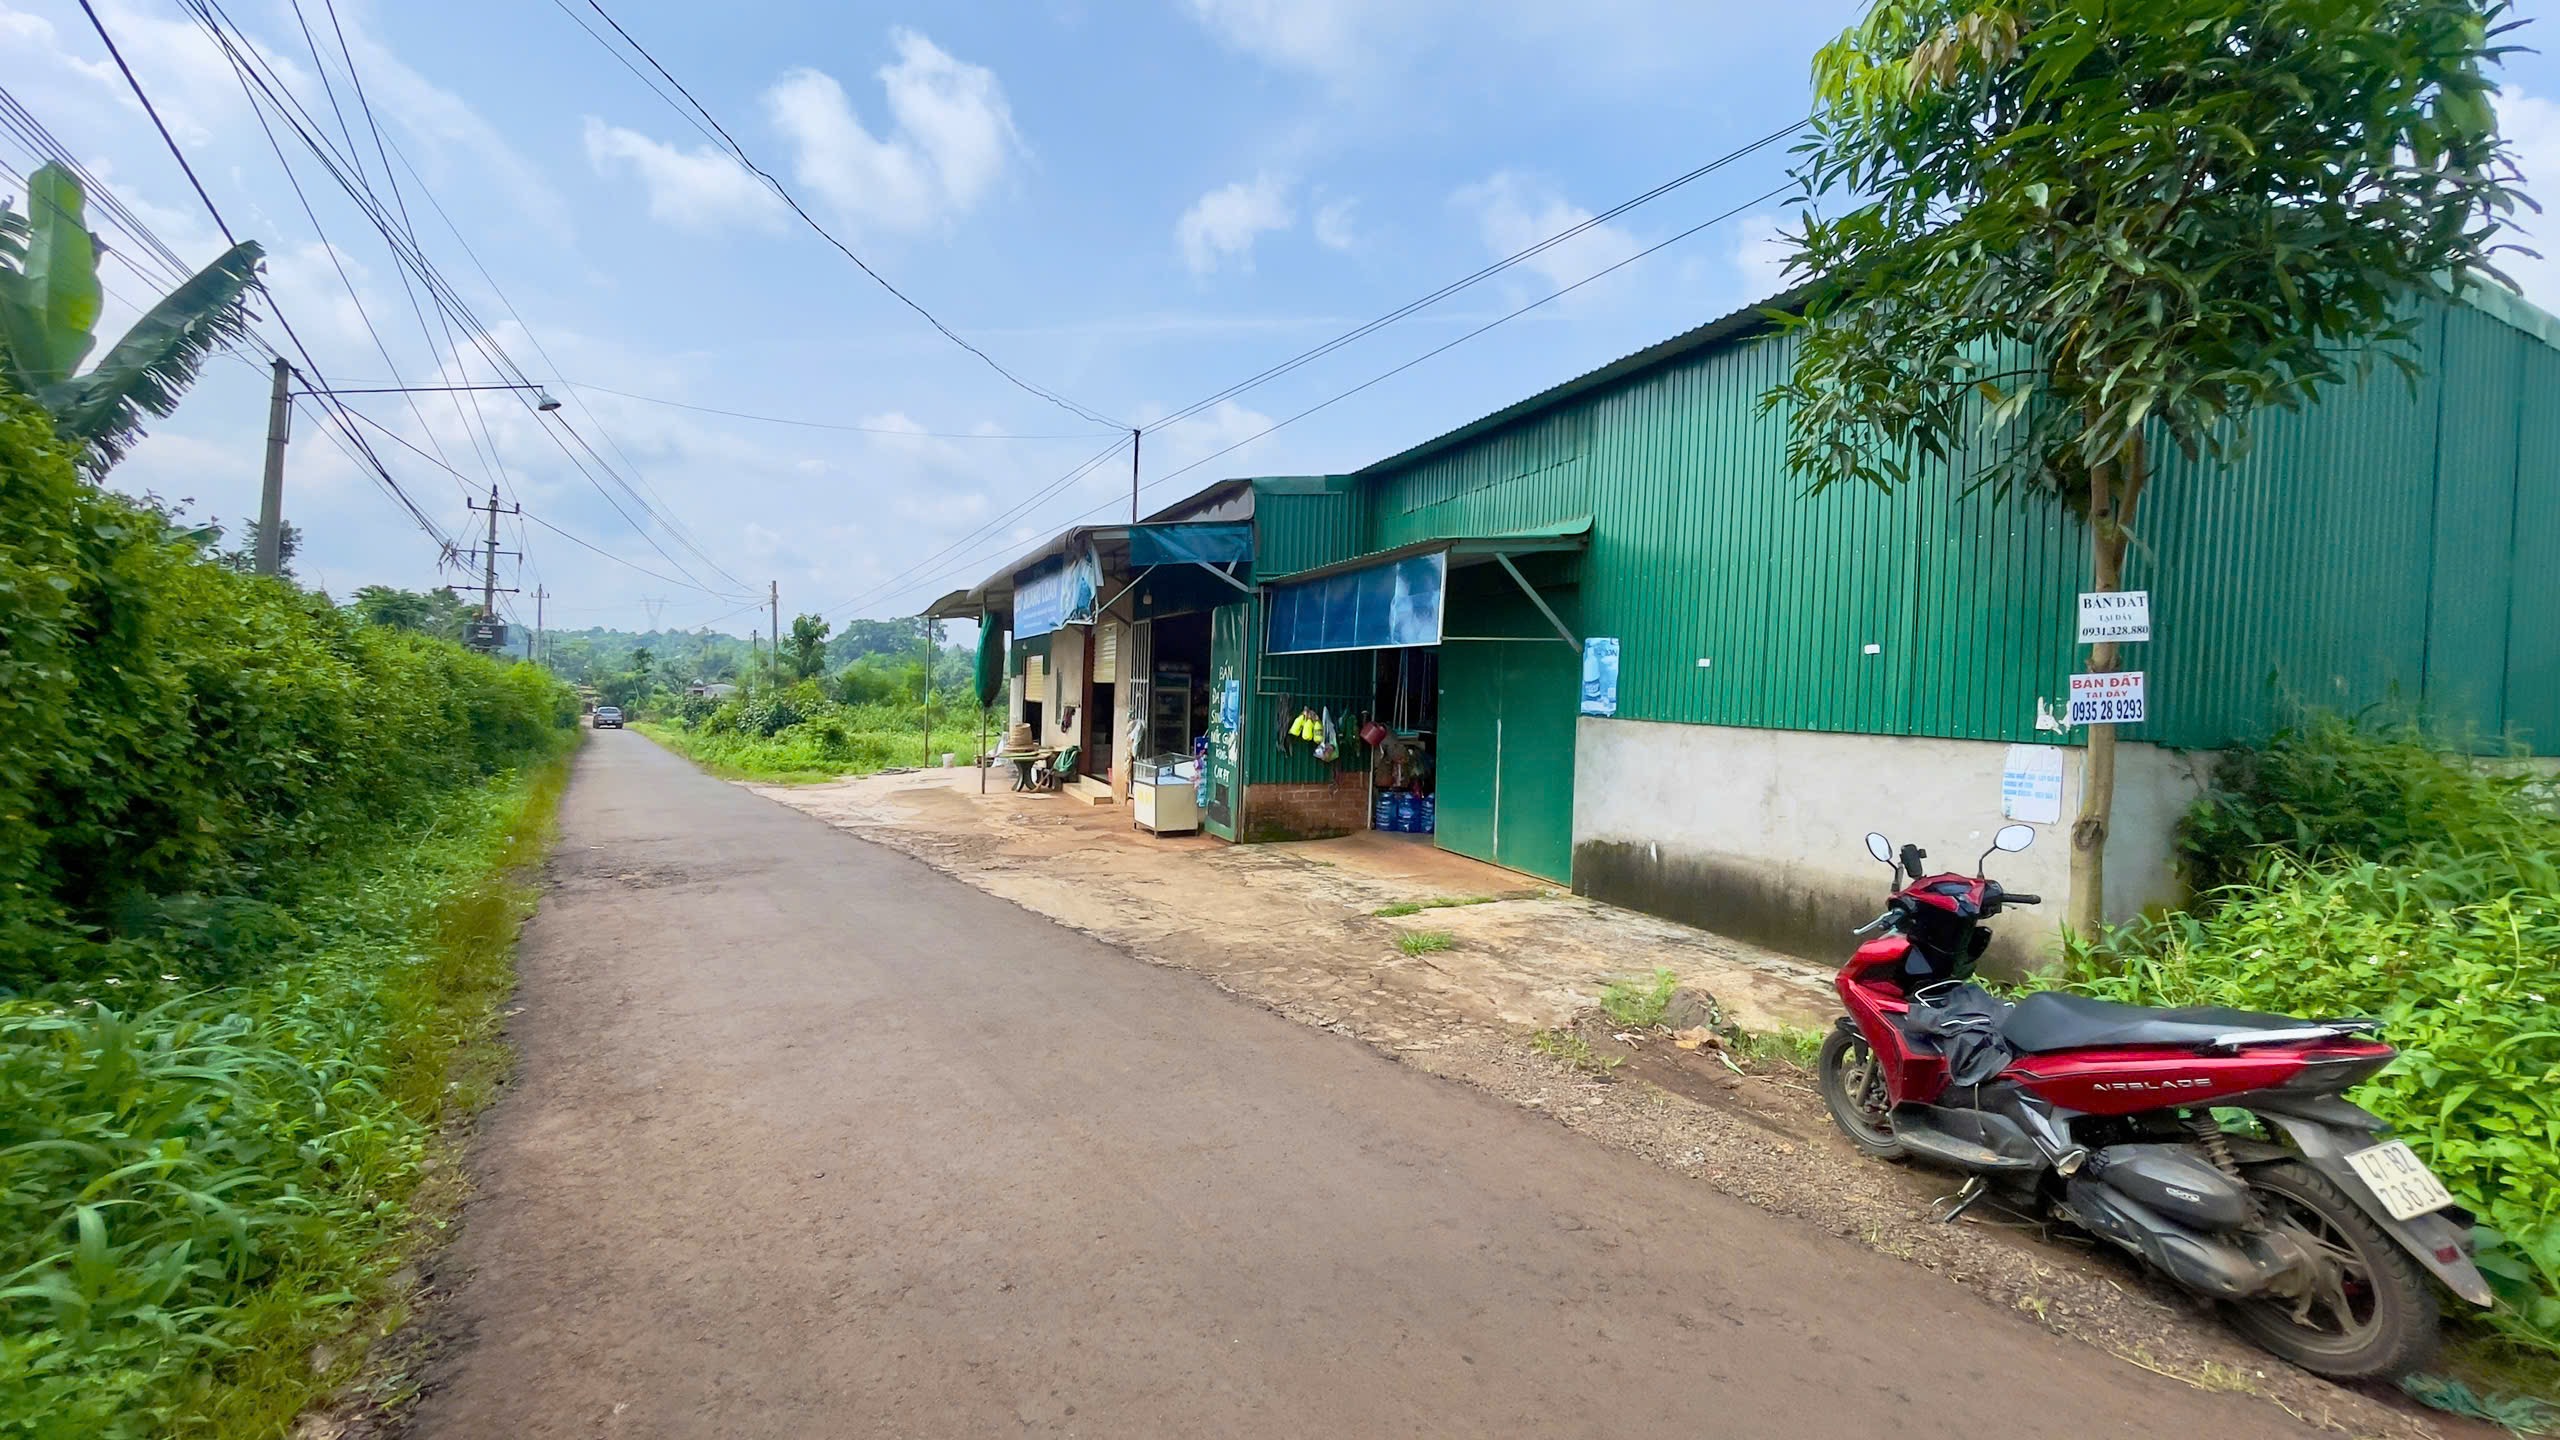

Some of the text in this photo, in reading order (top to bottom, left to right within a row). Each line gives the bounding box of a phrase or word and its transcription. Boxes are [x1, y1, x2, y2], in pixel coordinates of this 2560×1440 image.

[2072, 699, 2143, 721] 0935 28 9293
[2093, 1078, 2212, 1091] AIRBLADE
